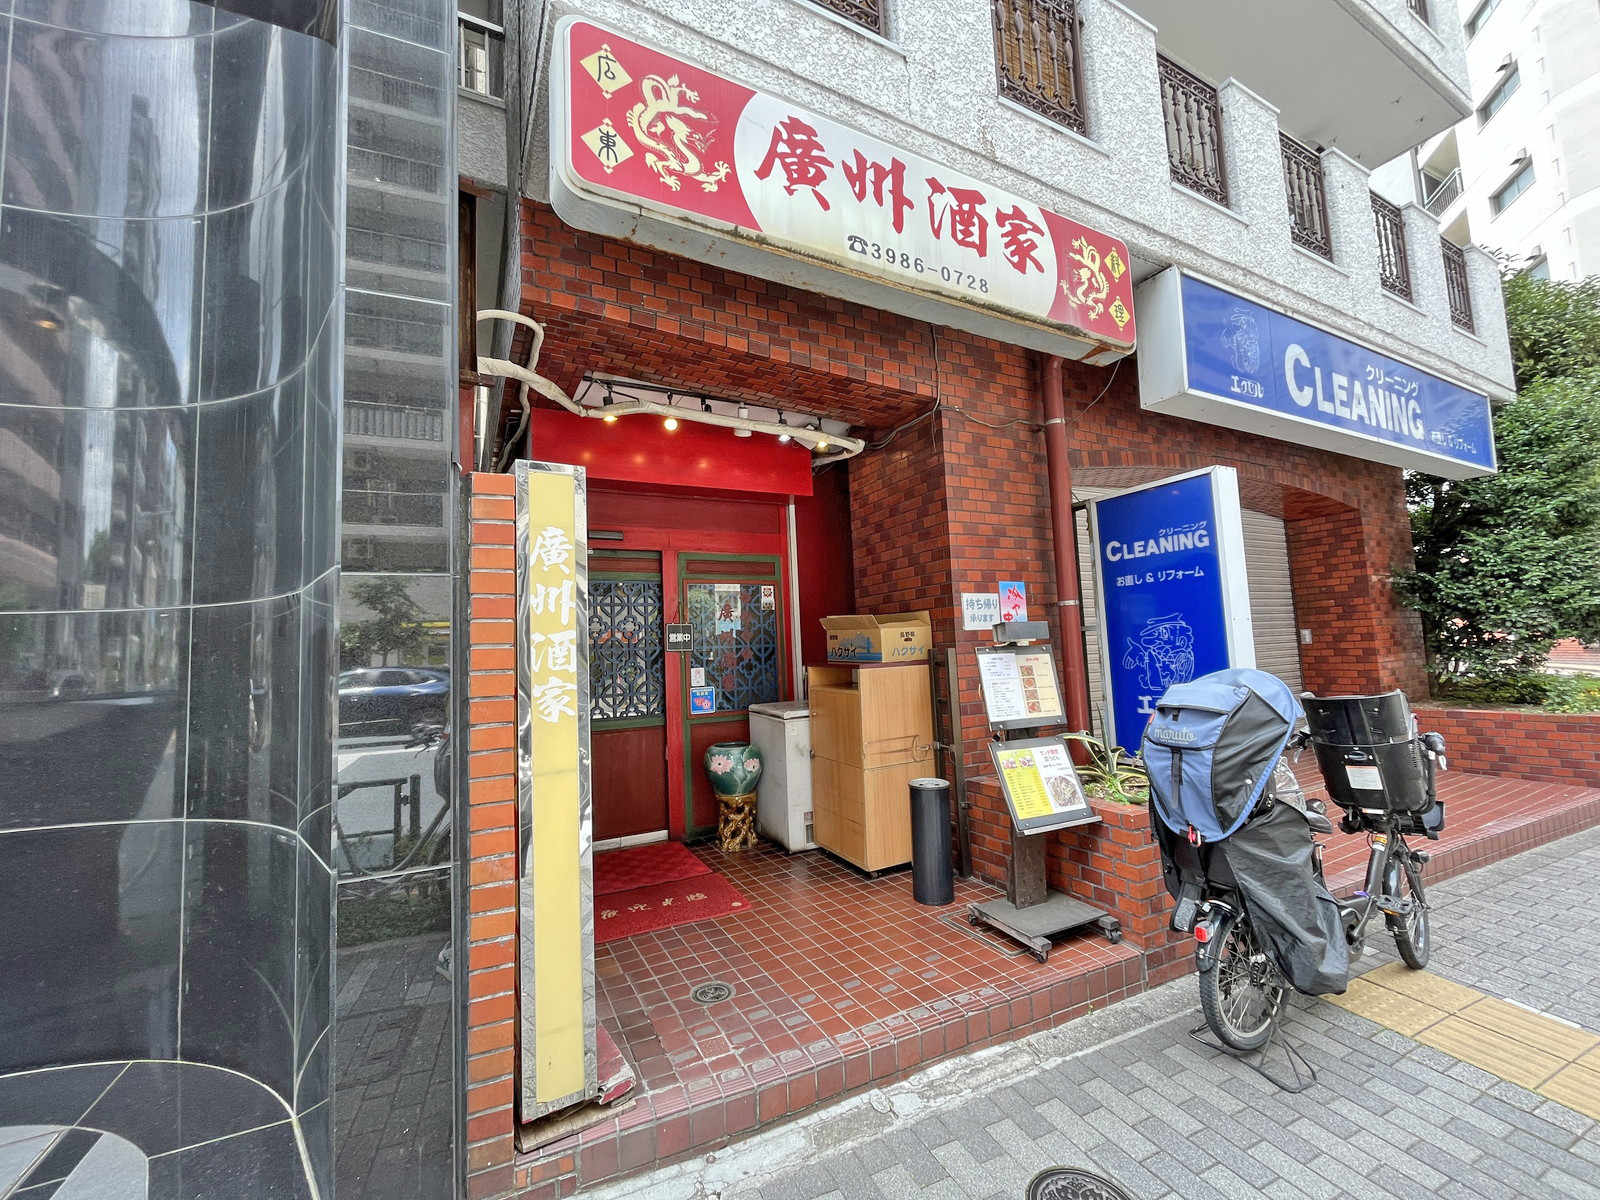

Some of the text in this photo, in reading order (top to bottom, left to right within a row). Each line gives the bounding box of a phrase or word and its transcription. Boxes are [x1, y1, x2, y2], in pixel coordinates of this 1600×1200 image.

[754, 115, 1045, 275] 廣州酒家
[871, 243, 989, 294] 3986-0728
[1284, 343, 1425, 440] CLEANING
[1365, 364, 1419, 397] クリーニング
[1159, 520, 1207, 536] クリーニング
[1106, 530, 1210, 563] CLEANING
[1116, 574, 1143, 587] お直し
[1157, 565, 1205, 582] リフォーム
[965, 598, 998, 610] 持ち帰り
[530, 526, 577, 723] 廣州酒家
[970, 613, 995, 623] 承ります
[669, 632, 691, 643] 営業中
[831, 646, 857, 658] ハクサイ
[892, 645, 925, 657] ハクサイ
